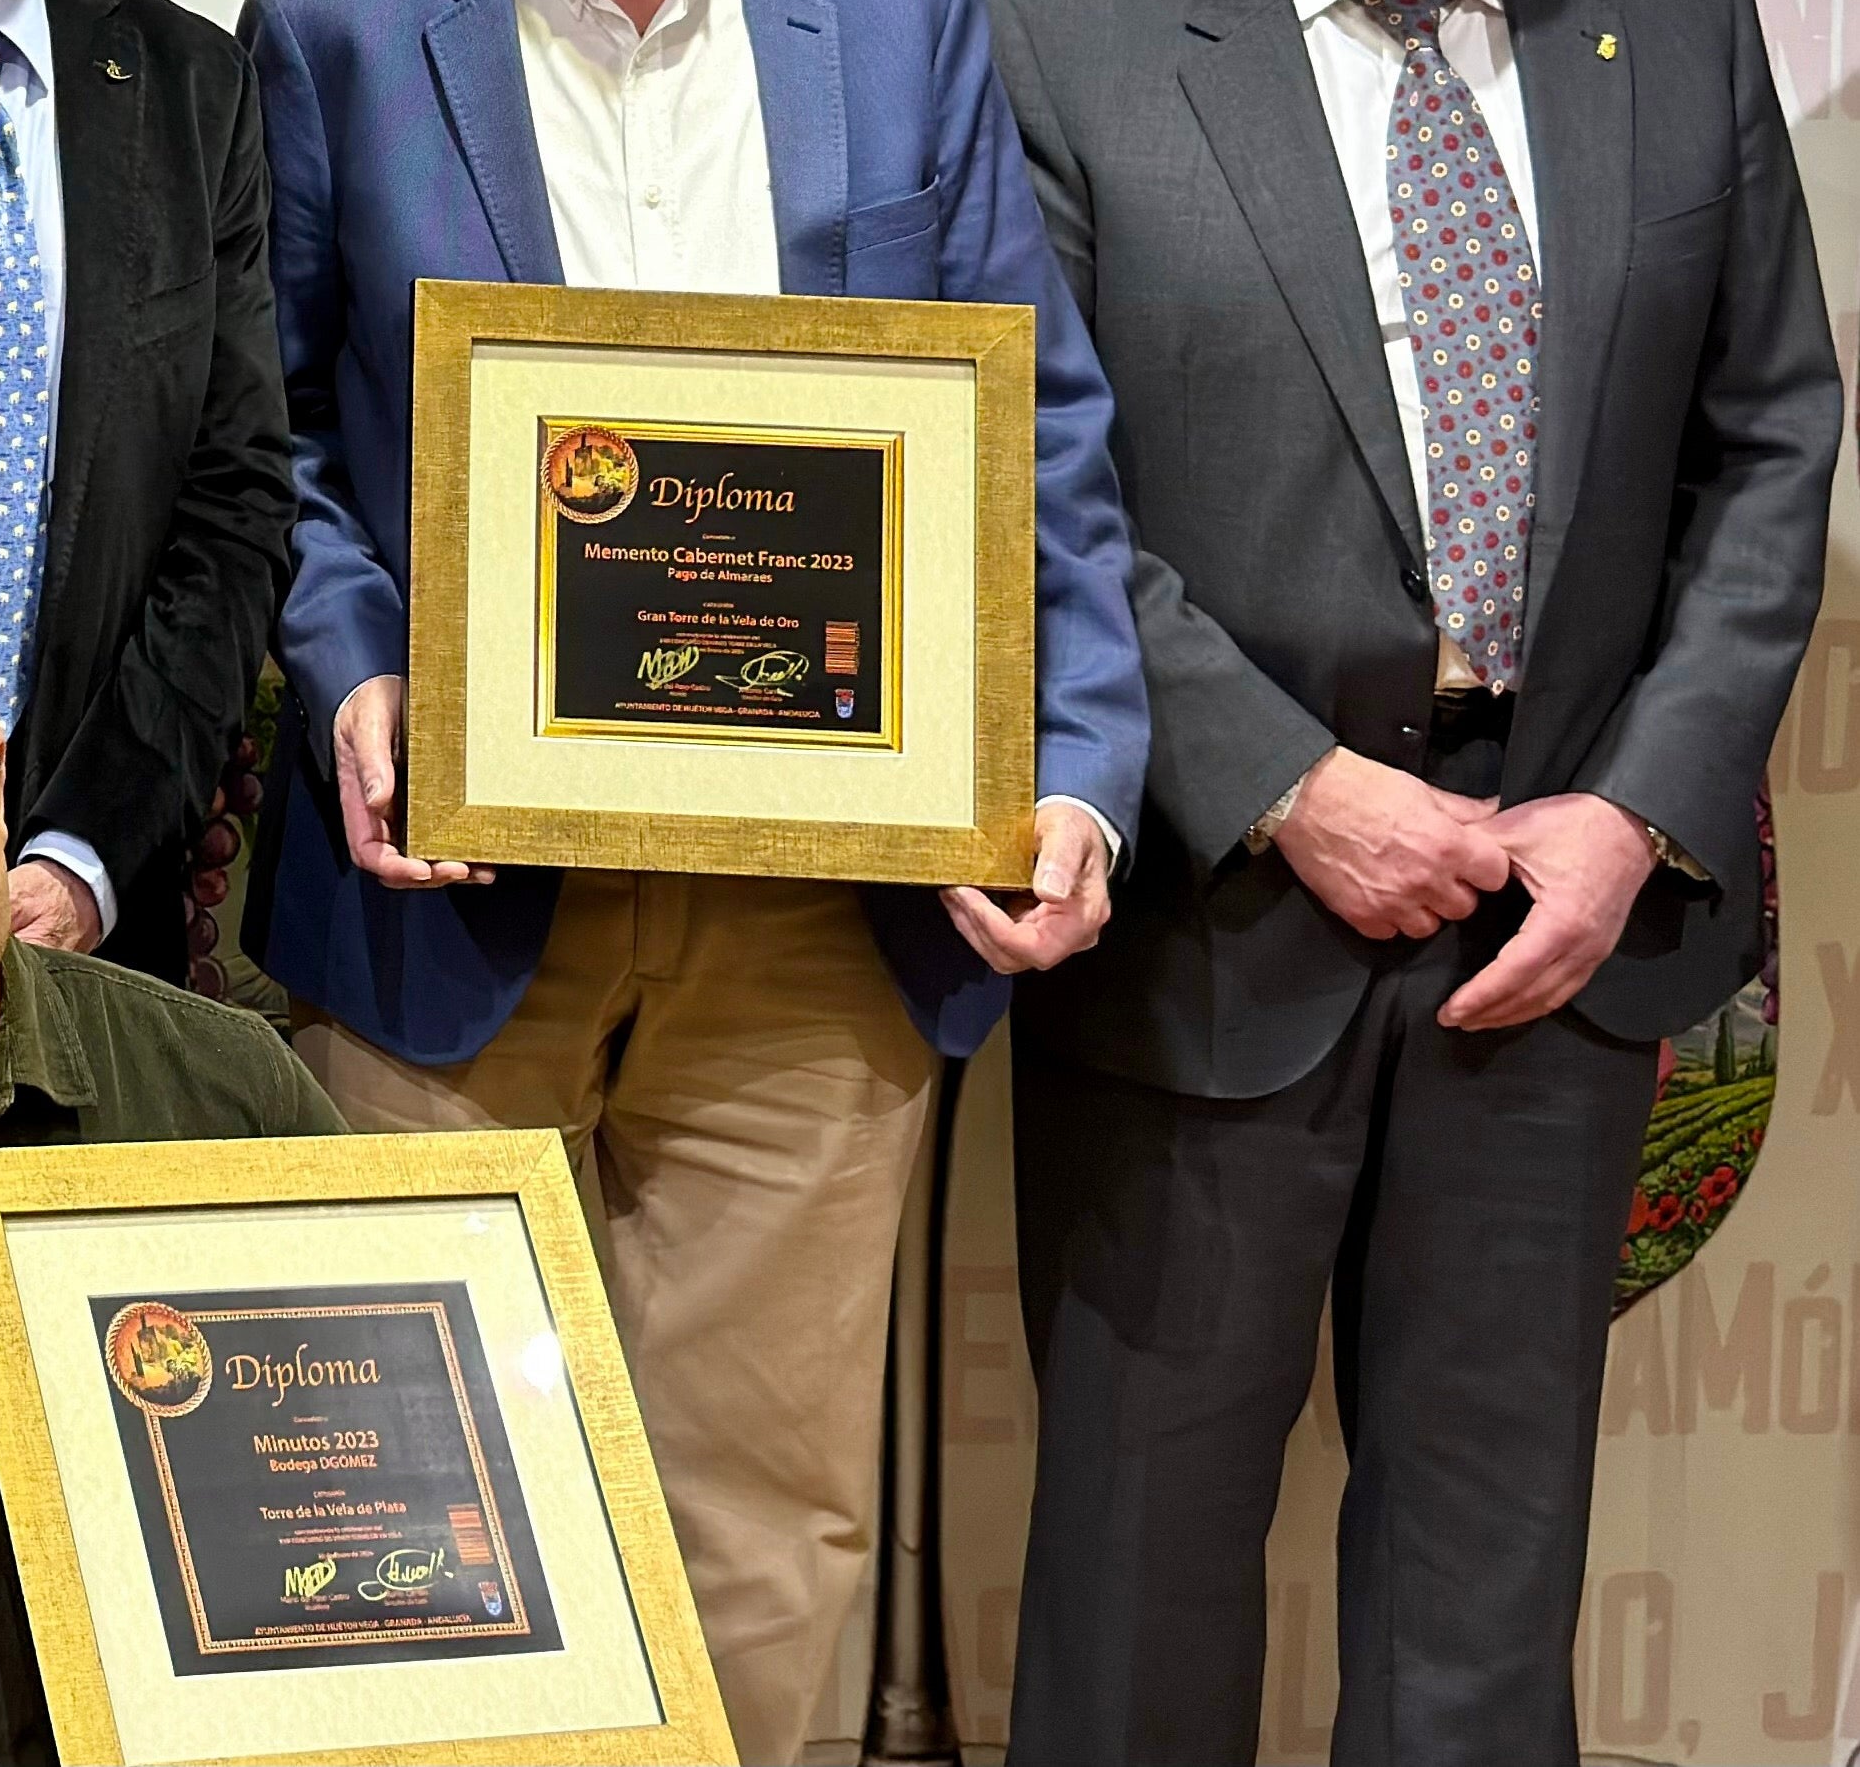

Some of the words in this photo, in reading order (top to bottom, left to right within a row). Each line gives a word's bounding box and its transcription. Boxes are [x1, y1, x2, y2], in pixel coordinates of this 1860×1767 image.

[649, 472, 796, 524] Diploma
[584, 543, 669, 563] Memento
[673, 547, 755, 567] Cabernet
[758, 551, 807, 569] Franc
[810, 554, 854, 571] 2023
[667, 567, 698, 582] Pago
[699, 569, 715, 581] de
[717, 570, 773, 584] Almaraes
[637, 610, 666, 623] Gran
[668, 612, 699, 624] Torre
[701, 612, 716, 625] de
[718, 613, 730, 626] la
[732, 614, 757, 627] Vela
[759, 615, 775, 628] de
[777, 616, 800, 629] Oro
[225, 1343, 381, 1406] Diploma
[253, 1434, 331, 1454] Minutos
[335, 1430, 379, 1451] 2023
[268, 1458, 318, 1474] Bodega
[259, 1506, 295, 1521] Torre
[296, 1505, 313, 1519] de
[314, 1504, 325, 1517] la
[326, 1503, 354, 1517] Vela
[356, 1502, 373, 1516] de
[374, 1500, 407, 1514] Plata
